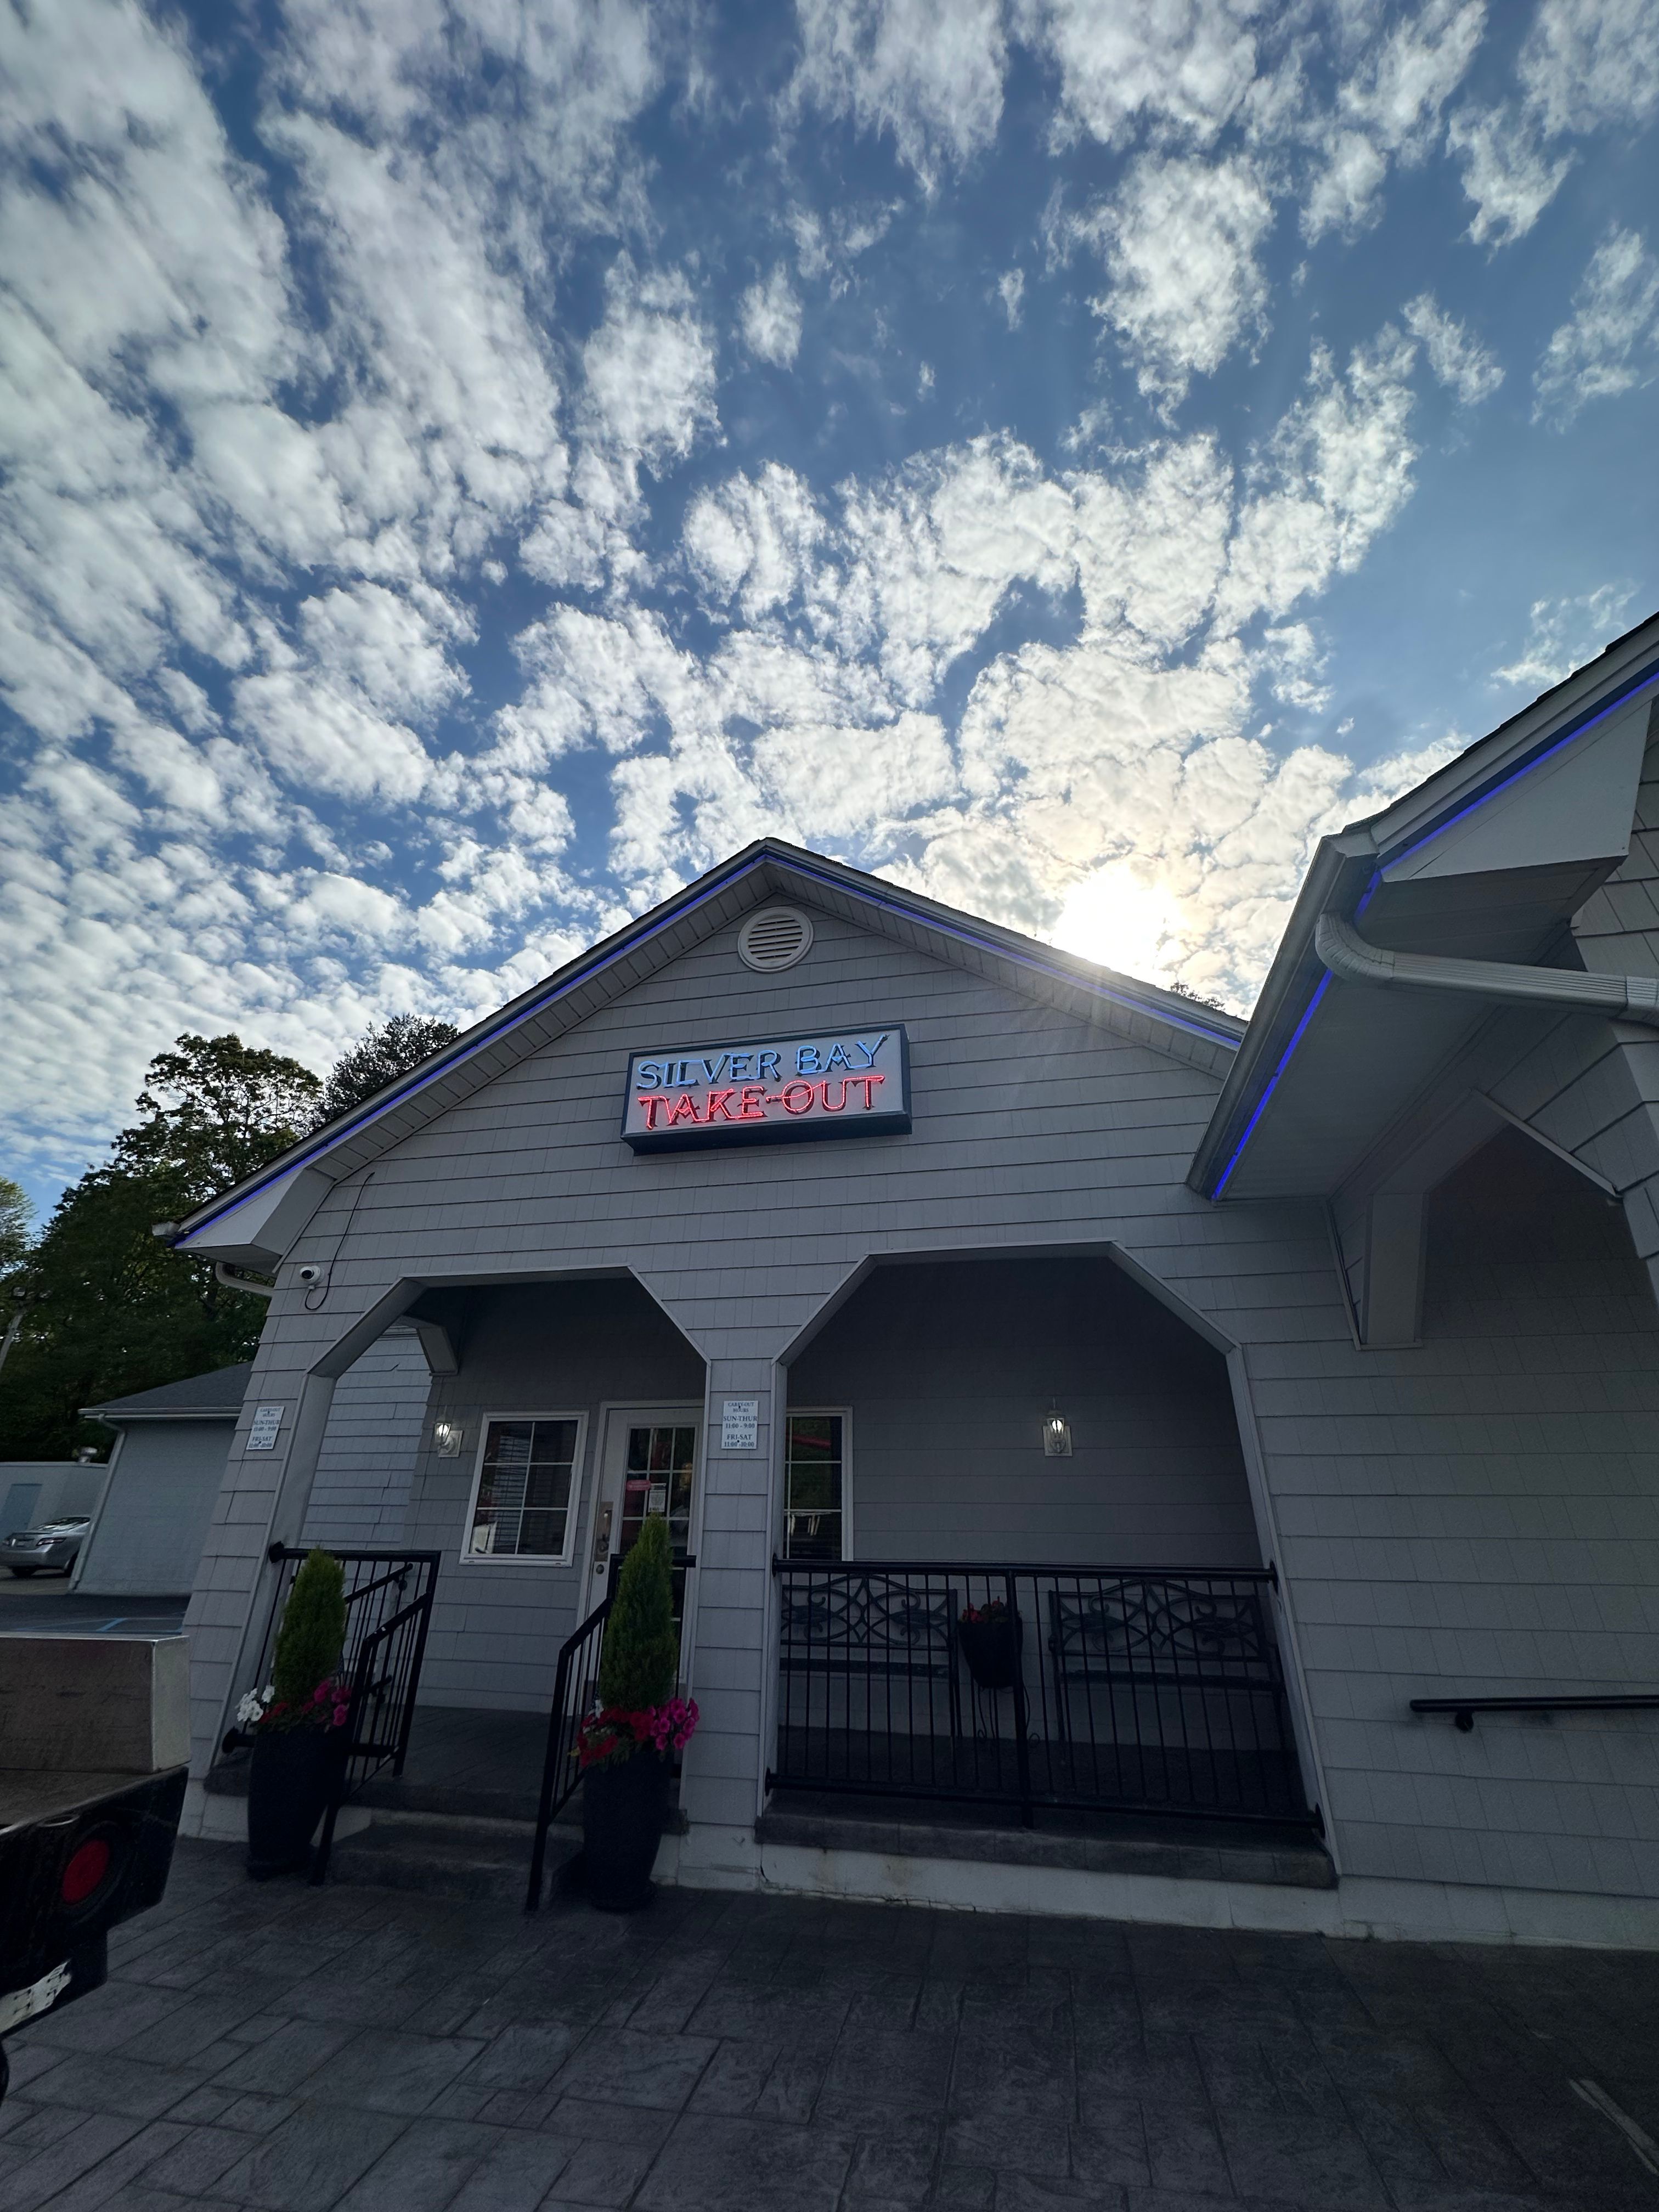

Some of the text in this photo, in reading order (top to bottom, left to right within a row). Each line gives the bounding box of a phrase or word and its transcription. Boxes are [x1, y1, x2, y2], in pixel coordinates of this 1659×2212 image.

[637, 1034, 890, 1089] SILVER BAY
[637, 1075, 886, 1130] TAKE-OUT
